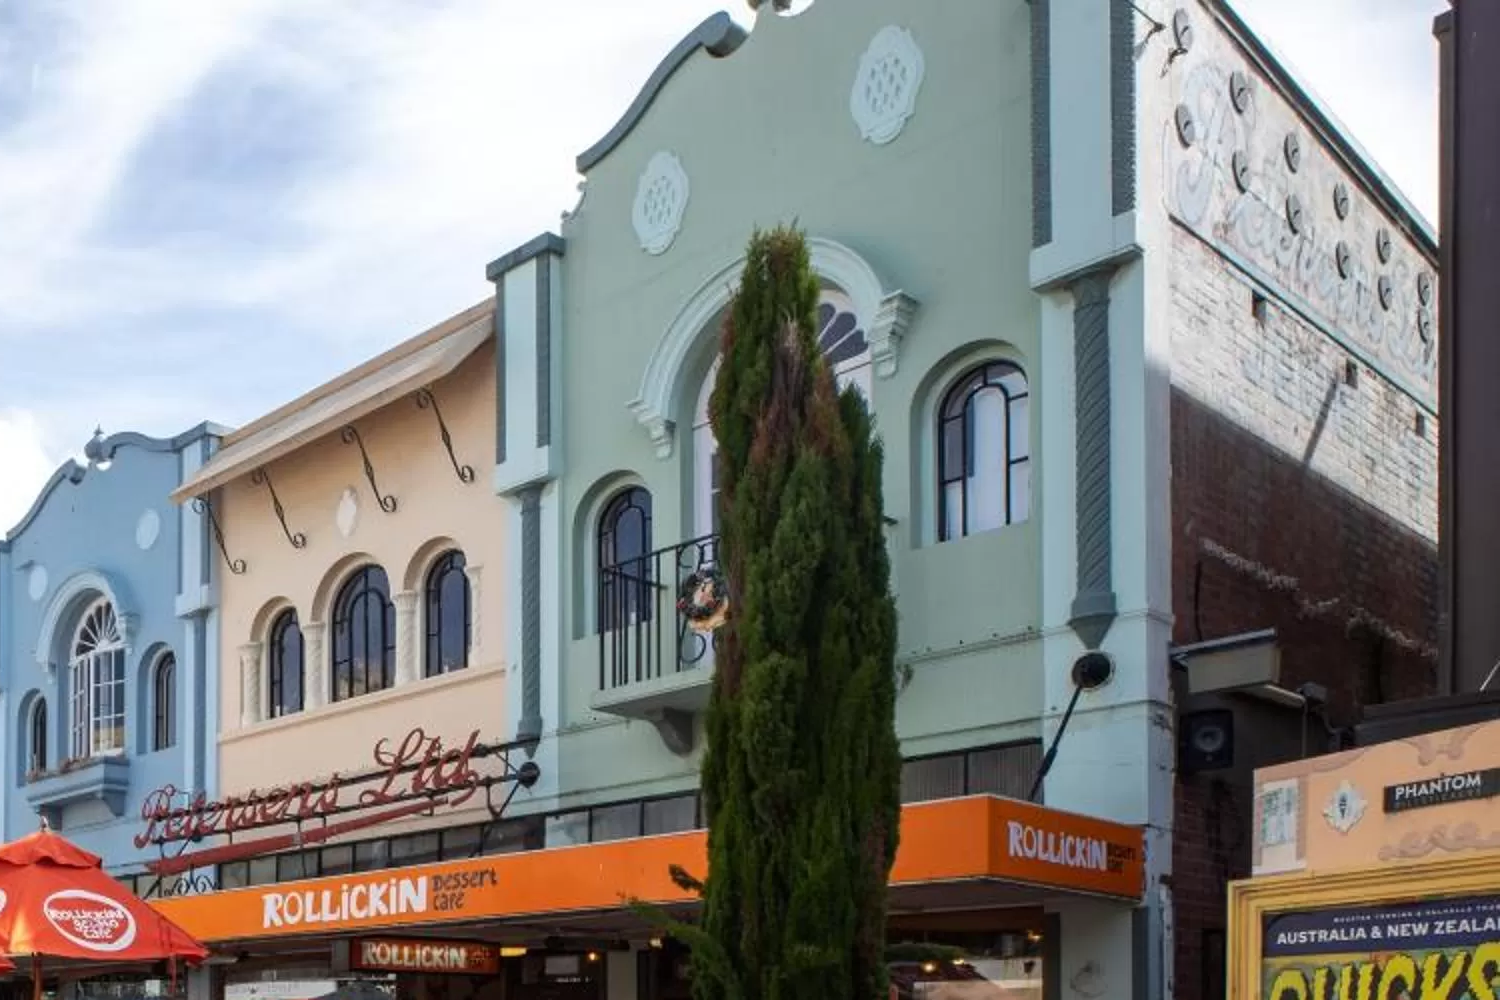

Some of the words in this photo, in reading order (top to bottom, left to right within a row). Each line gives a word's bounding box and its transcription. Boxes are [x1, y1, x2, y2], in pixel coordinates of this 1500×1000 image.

[1394, 773, 1481, 800] PHANTOM
[1371, 925, 1383, 940] &
[1387, 921, 1430, 938] NEW
[1433, 916, 1500, 935] ZEALA
